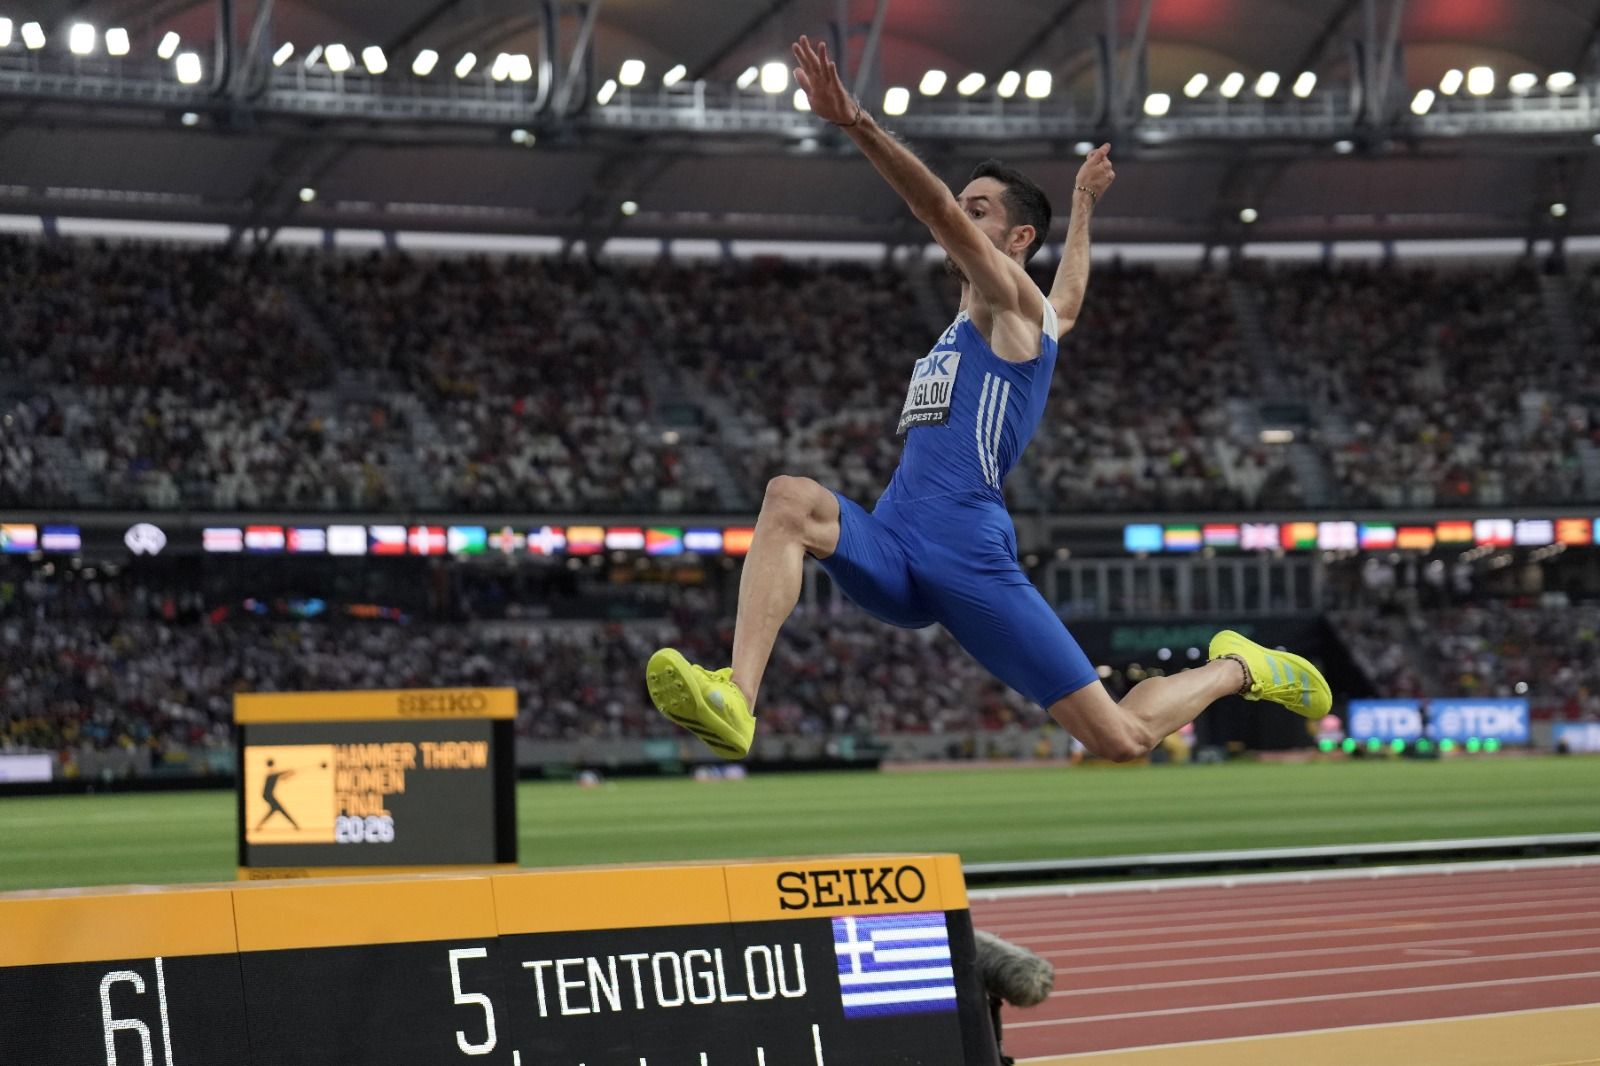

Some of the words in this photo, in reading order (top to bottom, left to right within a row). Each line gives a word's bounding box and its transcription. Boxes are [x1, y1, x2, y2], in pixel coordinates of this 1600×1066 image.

[398, 691, 487, 715] SEIKO
[335, 742, 416, 769] HAMMER
[419, 740, 488, 769] THROW
[335, 768, 405, 793] WOMEN
[335, 792, 392, 817] FINAL
[777, 866, 925, 910] SEIKO
[449, 948, 497, 1055] 5
[521, 943, 806, 1018] TENTOGLOU
